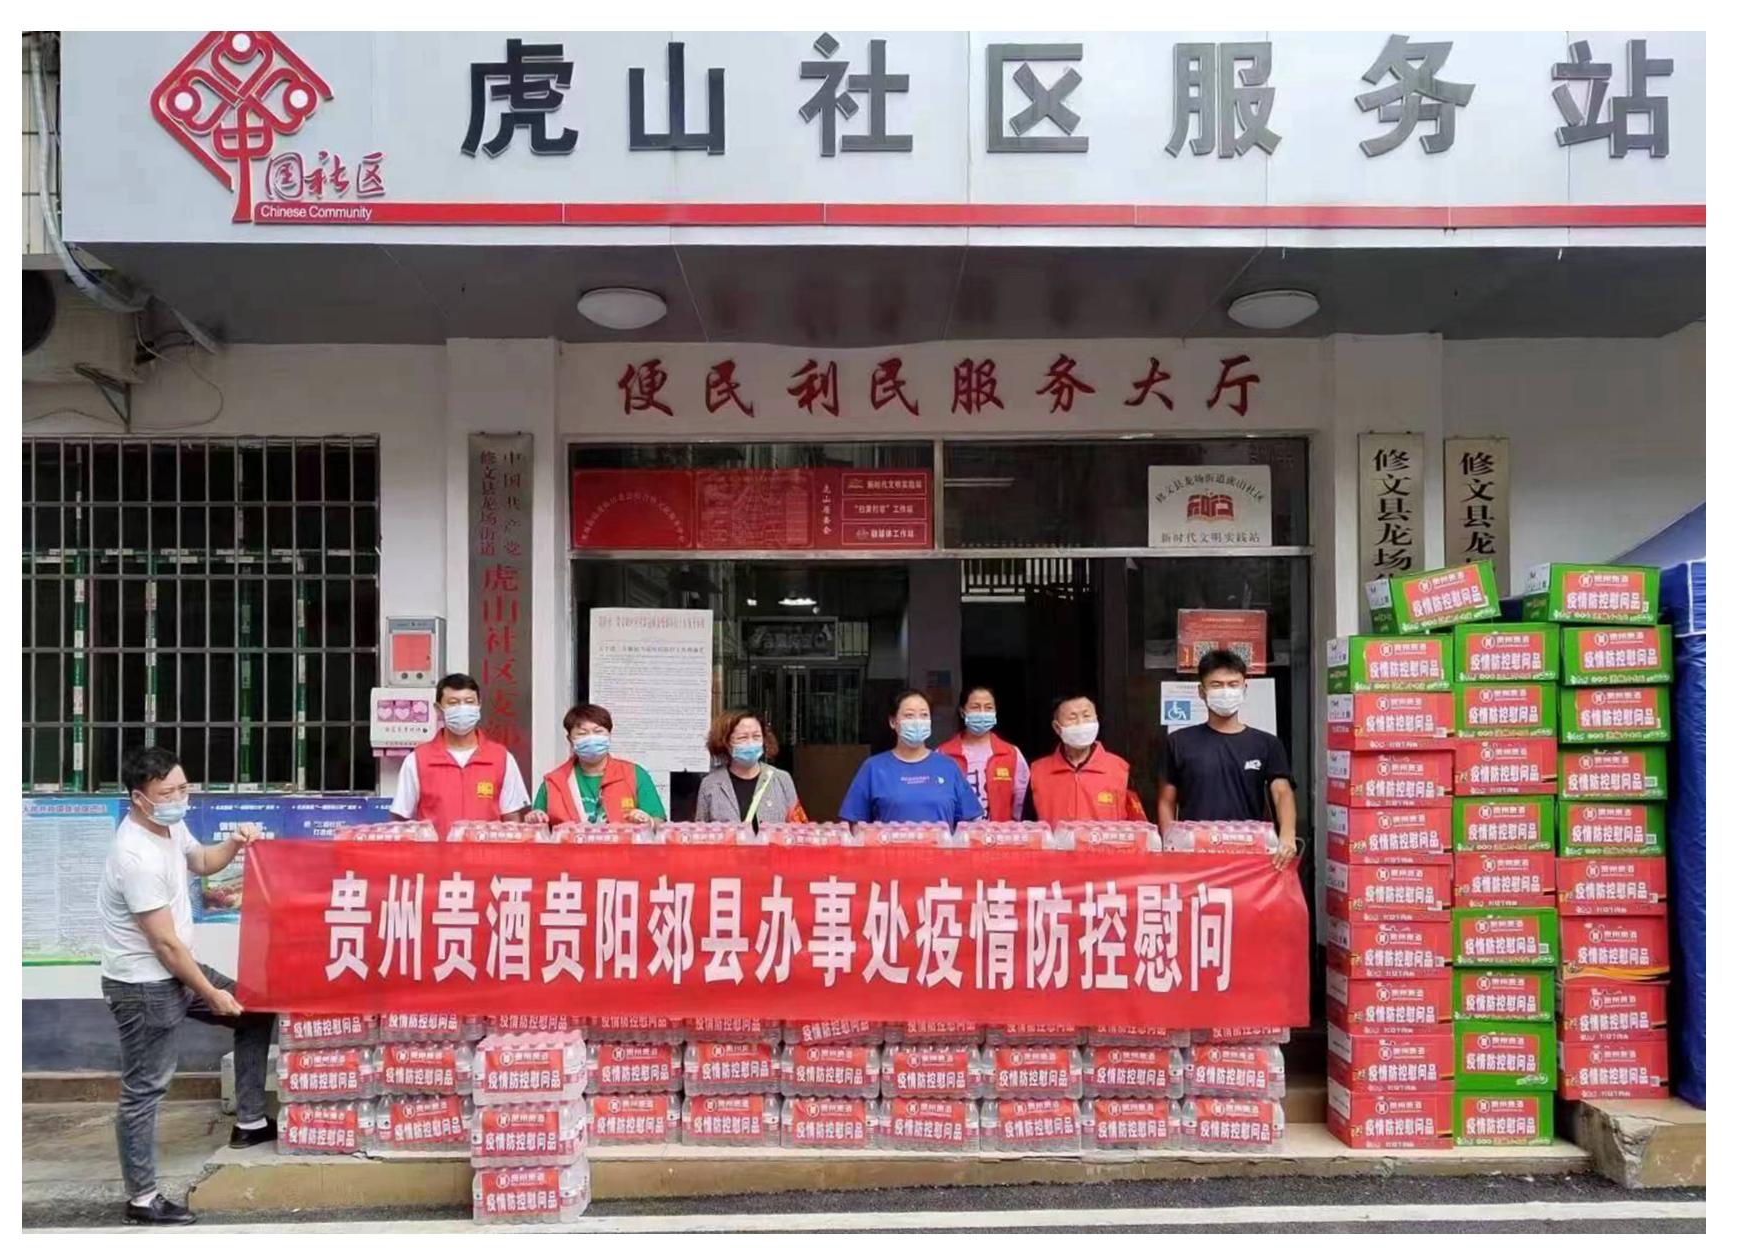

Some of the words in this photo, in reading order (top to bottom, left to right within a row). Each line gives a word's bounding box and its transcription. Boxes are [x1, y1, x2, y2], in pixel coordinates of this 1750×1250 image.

[459, 33, 1676, 159] 虎山社区服务站
[261, 205, 306, 218] Chinese
[309, 205, 373, 221] Community
[617, 355, 1262, 419] 便民利民服务大厅
[1460, 452, 1496, 562] 修文县龙
[1161, 531, 1260, 544] 新时代文明实践站
[1411, 587, 1485, 619] 疫情防控慰问品
[1566, 592, 1641, 612] 疫情防控慰问品
[1470, 651, 1541, 672] 疫情防控慰问品
[1583, 647, 1658, 669] 疫情防控慰问品
[1369, 659, 1440, 680] 疫情防控慰问品
[1365, 715, 1435, 734] 疫情防控慰问品
[1468, 706, 1538, 725] 疫情防控慰问品
[1580, 707, 1655, 728] 疫情防控慰问品
[1470, 764, 1540, 783] 疫情防控慰问品
[1567, 773, 1642, 792] 疫情防控慰问品
[1365, 780, 1435, 799] 疫情防控慰问品
[1468, 822, 1537, 842] 疫情防控慰问品
[1571, 824, 1643, 845] 疫情防控慰问品
[1368, 832, 1439, 853] 疫情防控慰问品
[1471, 874, 1541, 893] 疫情防控慰问品
[1575, 882, 1649, 900] 疫情防控慰问品
[1365, 886, 1435, 905] 疫情防控慰问品
[323, 869, 1233, 994] 贵州贵酒贵阳郊县办事处疫情防控慰问
[1464, 935, 1537, 955] 疫情防控慰问品
[1364, 949, 1434, 969] 疫情防控慰问品
[1578, 946, 1649, 966] 疫情防控慰问品
[1465, 993, 1537, 1012] 疫情防控慰问品
[1365, 1005, 1435, 1025] 疫情防控慰问品
[1579, 1013, 1649, 1031] 疫情防控慰问品
[702, 1061, 769, 1080] 疫情防控慰问品
[1465, 1053, 1536, 1072] 疫情防控慰问品
[289, 1072, 357, 1090] 疫情防控慰问品
[386, 1068, 454, 1086] 疫情防控慰问品
[487, 1071, 561, 1090] 疫情防控慰问品
[601, 1064, 670, 1082] 疫情防控慰问品
[796, 1066, 864, 1085] 疫情防控慰问品
[897, 1071, 966, 1089] 疫情防控慰问品
[999, 1069, 1069, 1088] 疫情防控慰问品
[1097, 1066, 1166, 1086] 疫情防控慰问品
[1195, 1066, 1266, 1088] 疫情防控慰问品
[1368, 1063, 1437, 1082] 疫情防控慰问品
[1579, 1067, 1649, 1086] 疫情防控慰问品
[393, 1117, 463, 1141] 疫情防控慰问品
[596, 1116, 664, 1134] 疫情防控慰问品
[694, 1115, 760, 1133] 疫情防控慰问品
[796, 1121, 864, 1140] 疫情防控慰问品
[894, 1118, 963, 1141] 疫情防控慰问品
[1005, 1117, 1073, 1139] 疫情防控慰问品
[1097, 1119, 1167, 1139] 疫情防控慰问品
[1200, 1120, 1271, 1141] 疫情防控慰问品
[1365, 1118, 1435, 1137] 疫情防控慰问品
[1466, 1116, 1536, 1136] 疫情防控慰问品
[288, 1126, 355, 1148] 疫情防控慰问品
[485, 1132, 558, 1150] 疫情防控慰问品
[486, 1190, 558, 1211] 疫情防控慰问品
